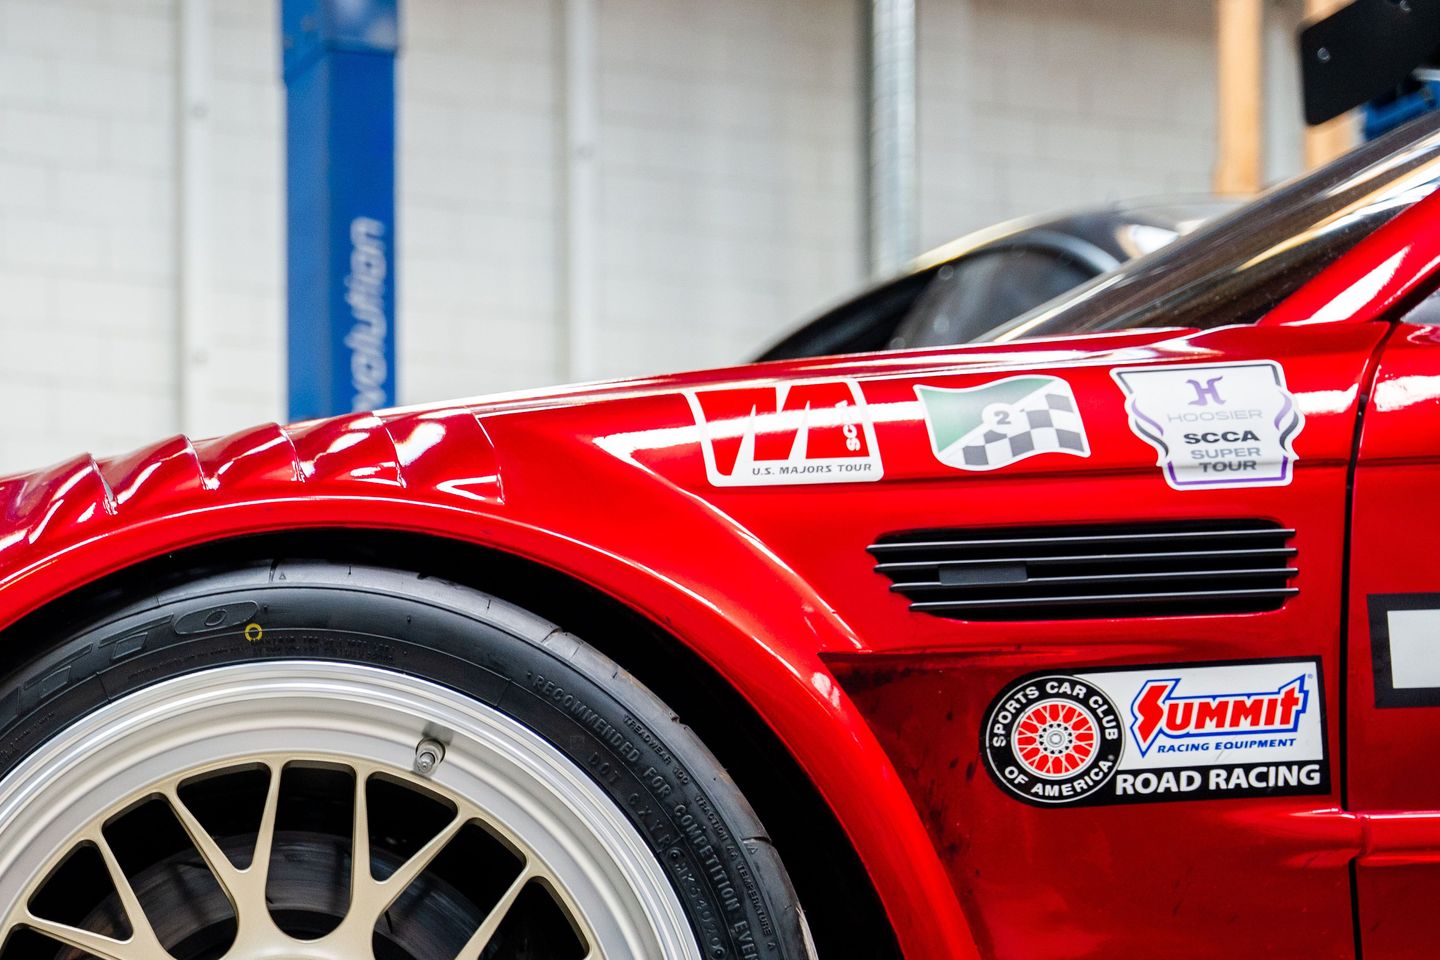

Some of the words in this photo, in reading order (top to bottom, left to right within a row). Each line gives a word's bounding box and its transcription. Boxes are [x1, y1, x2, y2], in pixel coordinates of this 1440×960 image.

[993, 411, 1011, 426] 2
[1167, 409, 1263, 423] HOOSIER
[1183, 430, 1261, 444] SCCA
[1190, 447, 1261, 459] SUPER
[752, 466, 776, 476] U.S.
[779, 465, 832, 474] MAJORS
[837, 463, 872, 472] TOUR
[1199, 460, 1257, 473] TOUR
[992, 686, 1040, 748] SPORTS
[1045, 681, 1087, 699] CAR
[1088, 695, 1119, 740] CLUB
[1157, 742, 1210, 754] RACING
[1214, 738, 1297, 751] EQUIPMENT
[1004, 766, 1029, 785] OF
[1030, 760, 1113, 797] AMERICA
[1115, 769, 1202, 795] ROAD
[1209, 764, 1321, 791] RACING
[531, 672, 641, 764] RECOMMENDED
[640, 765, 673, 799] FOR
[670, 801, 740, 912] COMPETITION
